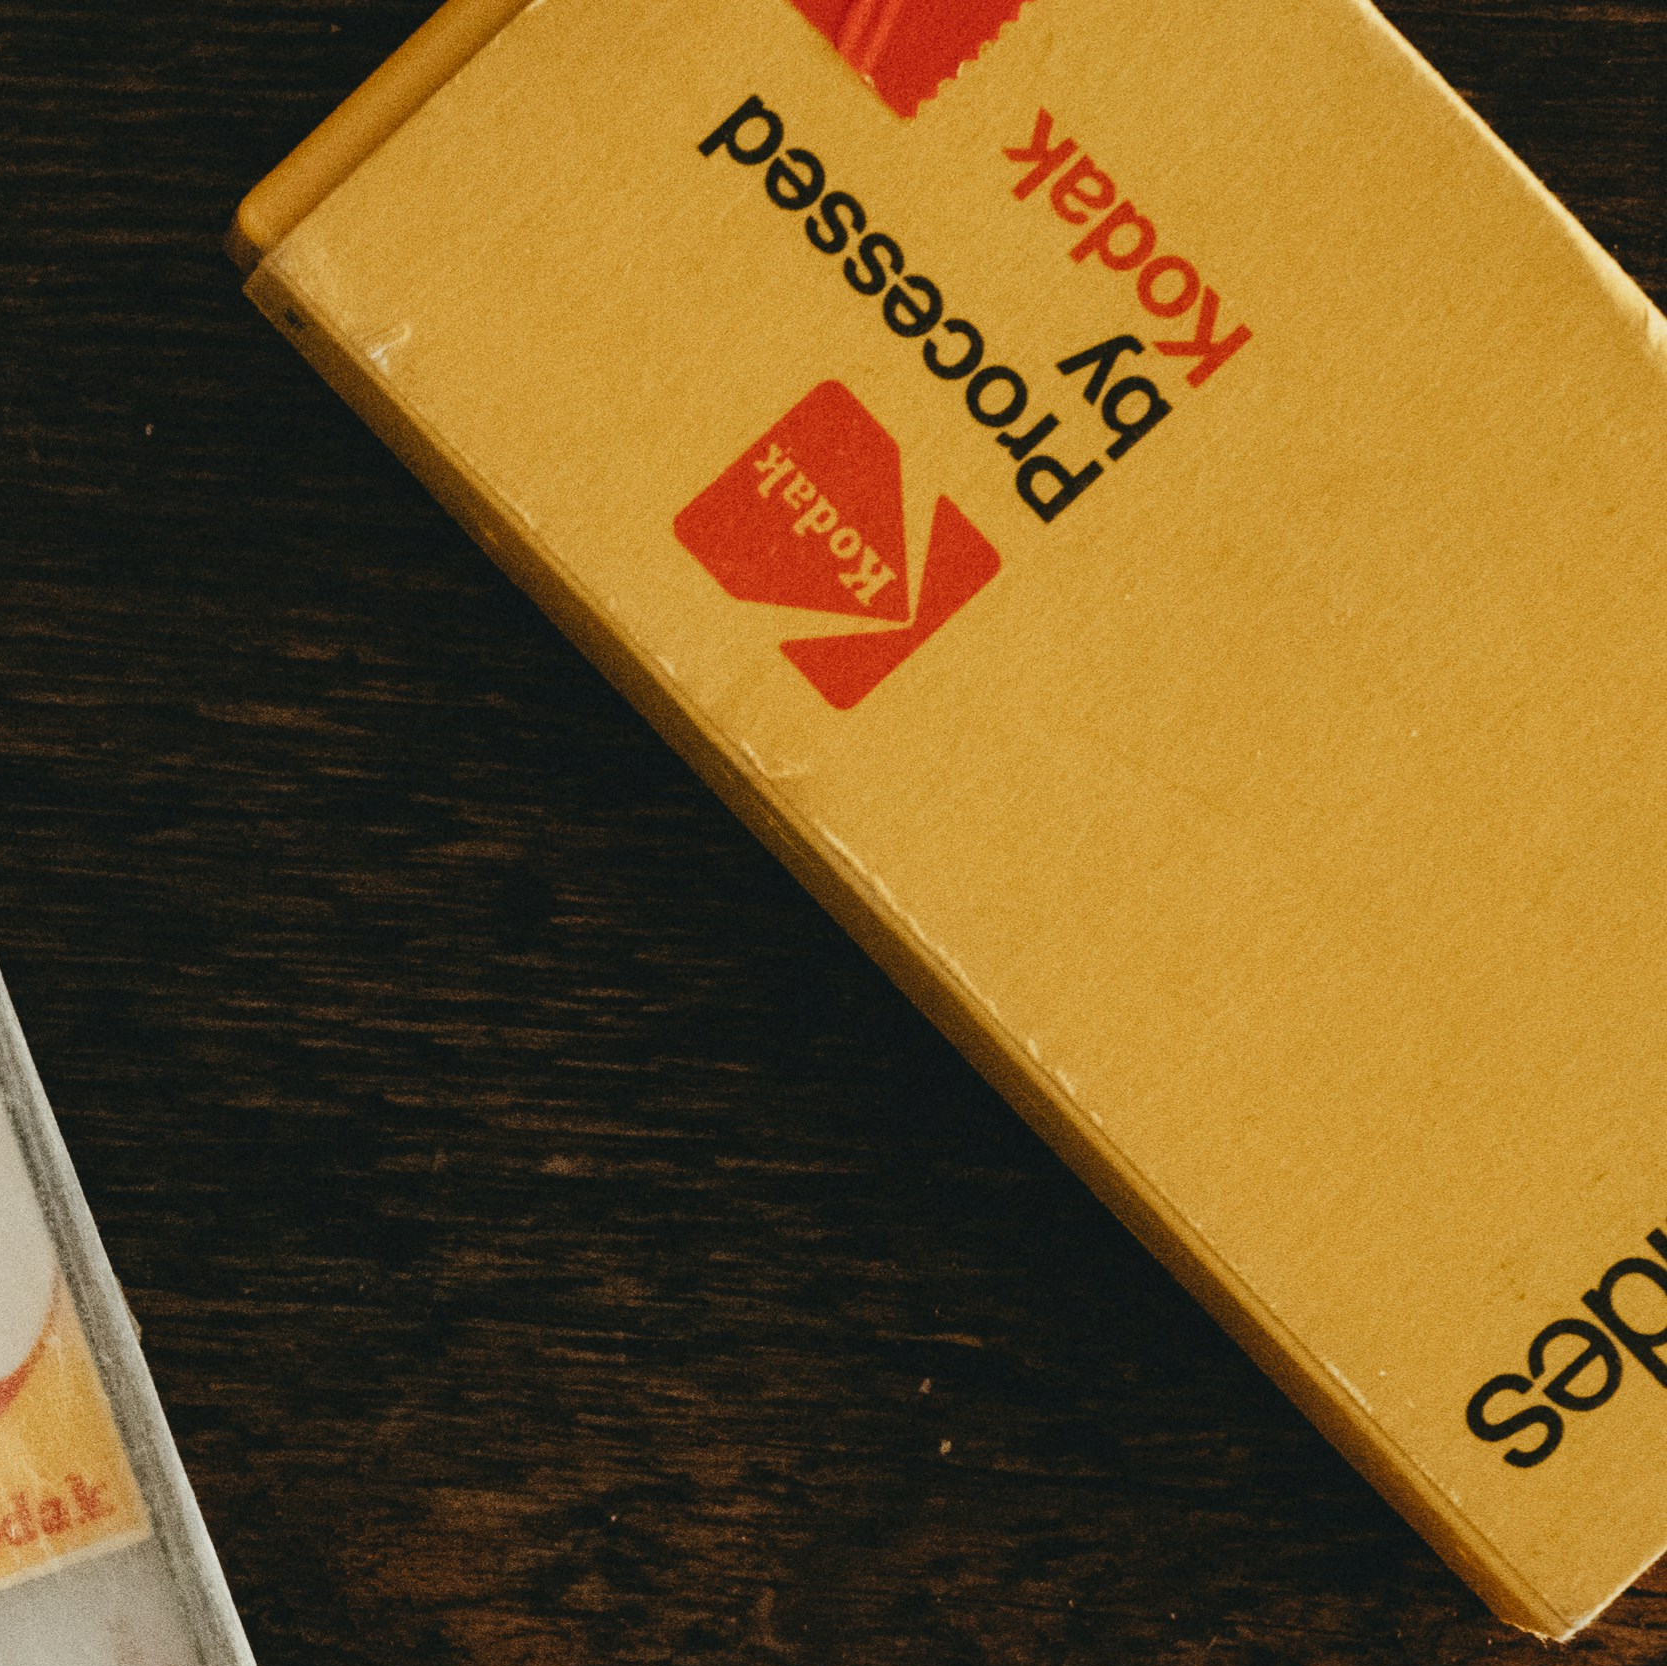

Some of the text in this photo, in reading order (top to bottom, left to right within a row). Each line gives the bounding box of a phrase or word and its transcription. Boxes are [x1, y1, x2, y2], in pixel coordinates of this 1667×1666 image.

[698, 94, 1103, 522] Processed
[1003, 107, 1253, 388] Kodak
[1056, 334, 1172, 461] by
[753, 442, 895, 608] Kodak
[1466, 1228, 1667, 1468] des
